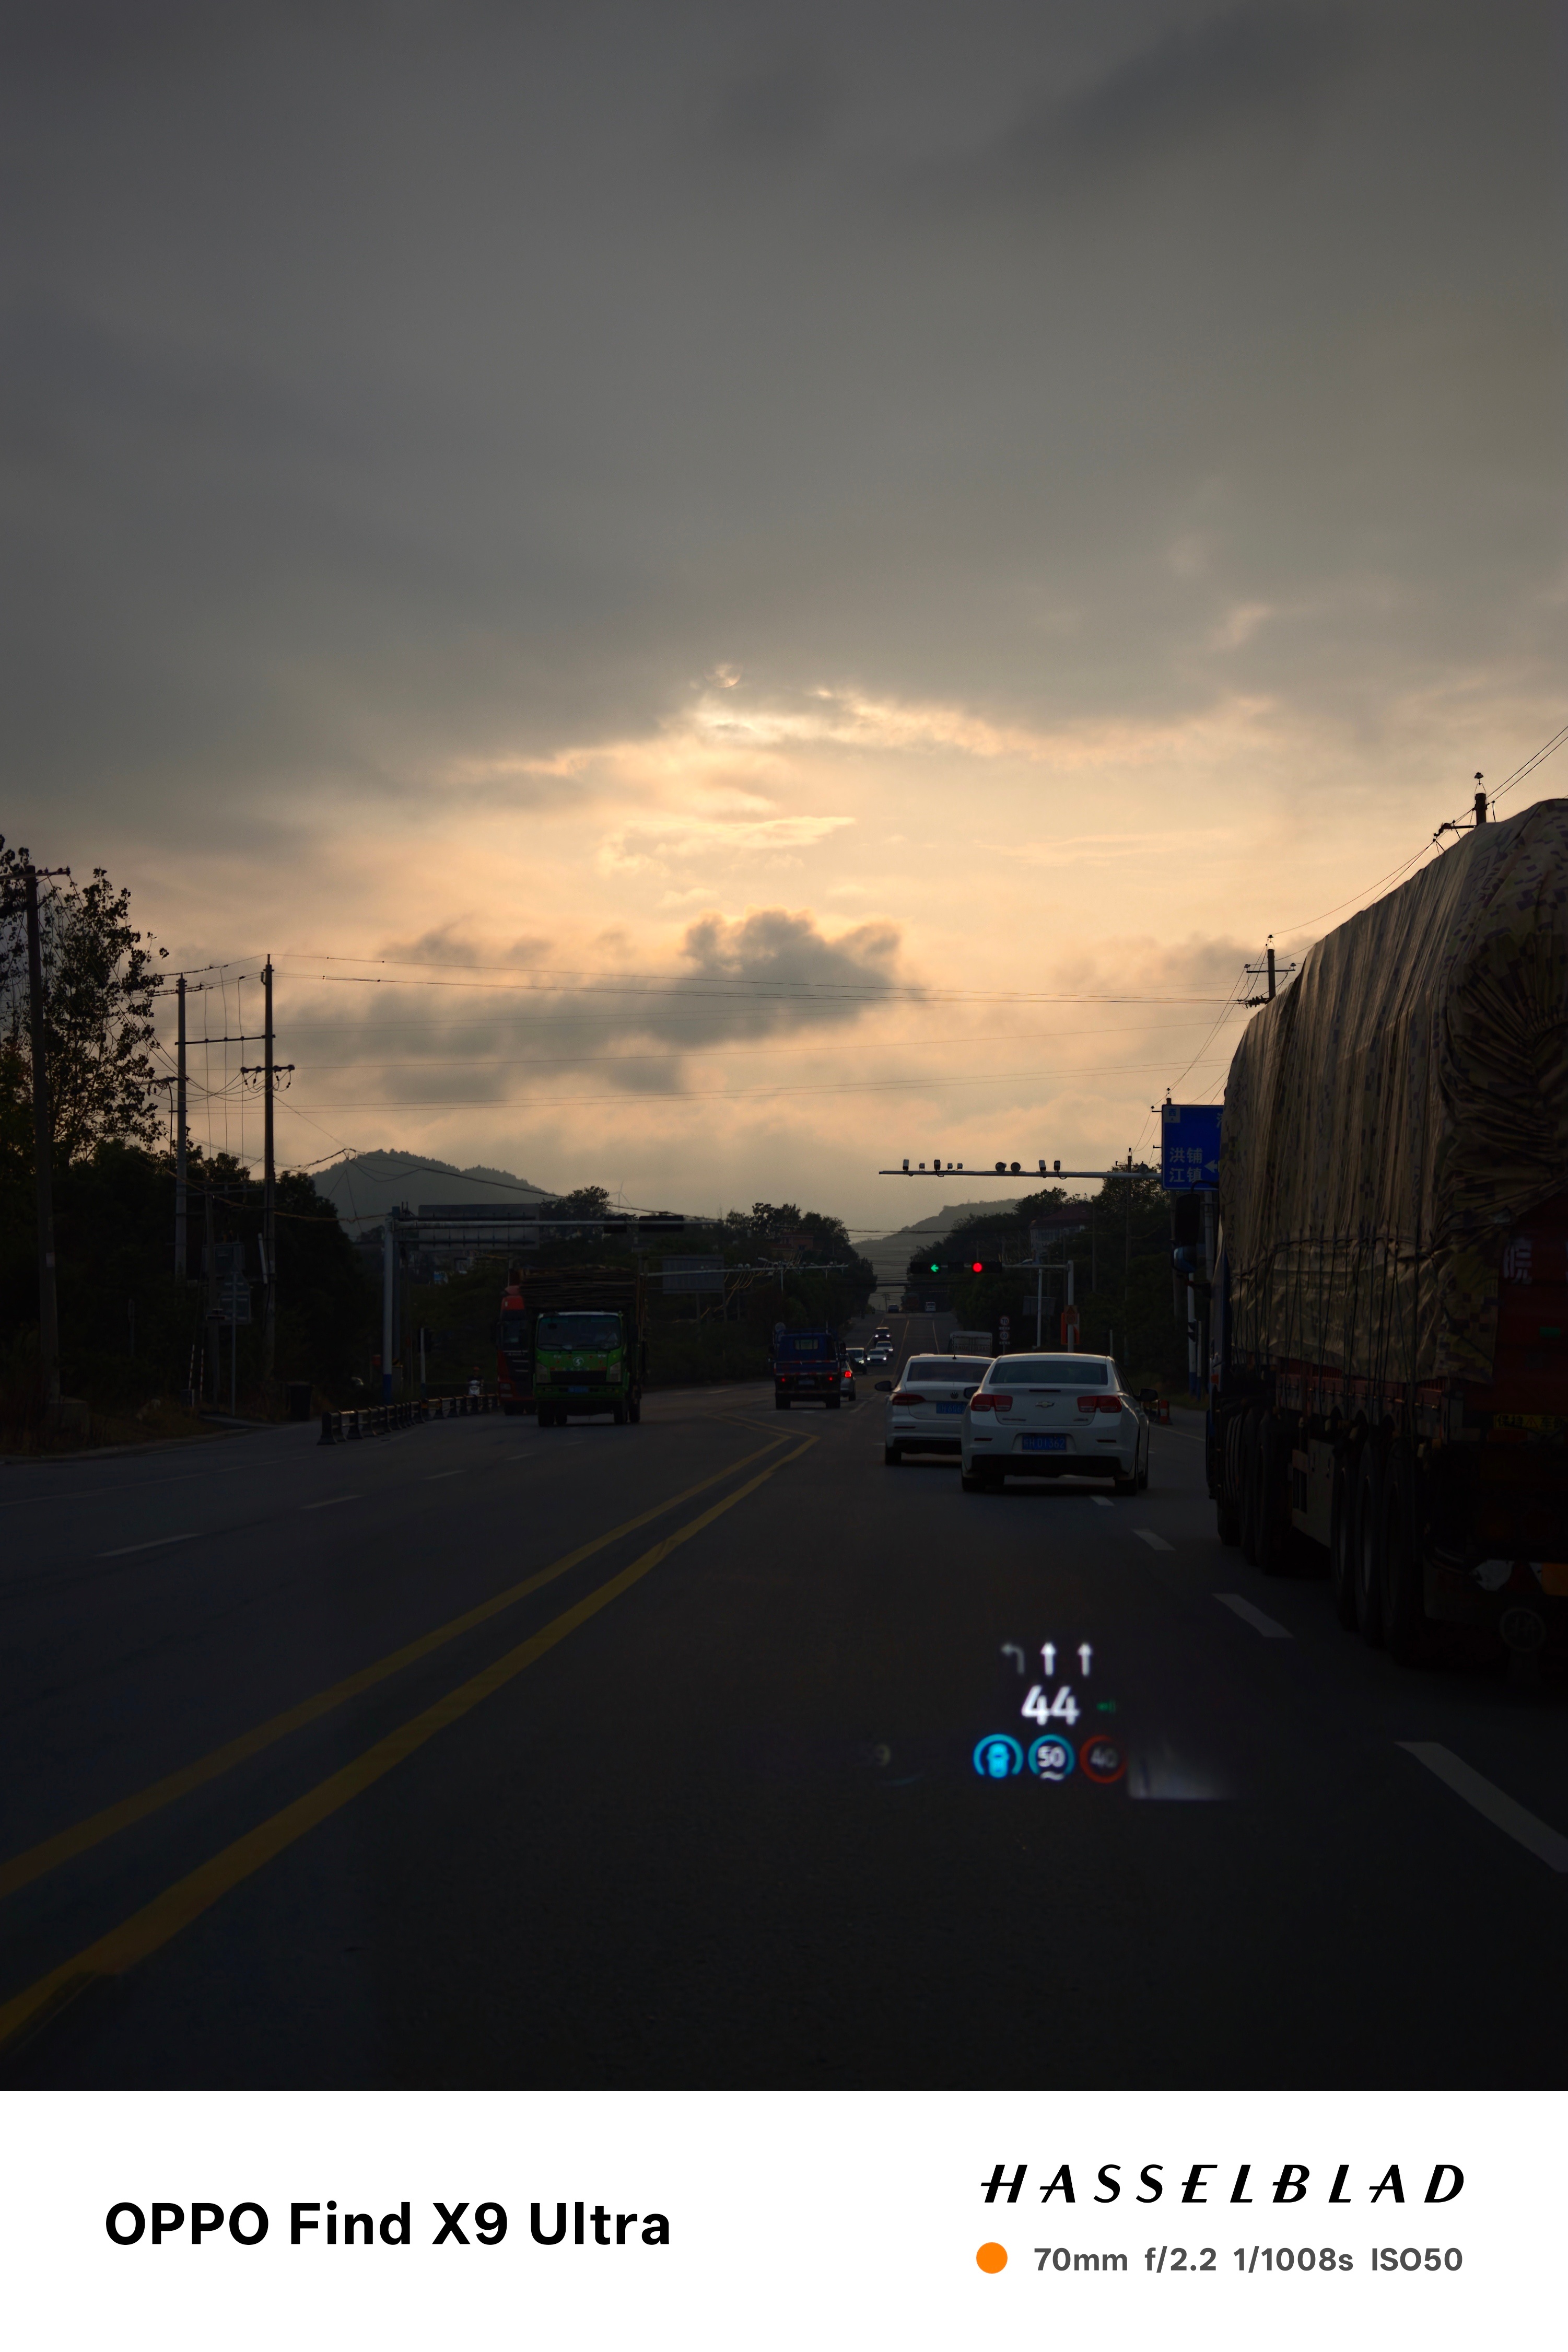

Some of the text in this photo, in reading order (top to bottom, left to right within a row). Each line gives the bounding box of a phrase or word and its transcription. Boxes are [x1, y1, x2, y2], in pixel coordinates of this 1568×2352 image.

[1169, 1147, 1203, 1164] 洪铺
[1169, 1167, 1203, 1183] 江镇
[1021, 1685, 1080, 1726] 44
[1037, 1745, 1066, 1768] 50
[1090, 1746, 1118, 1768] 40
